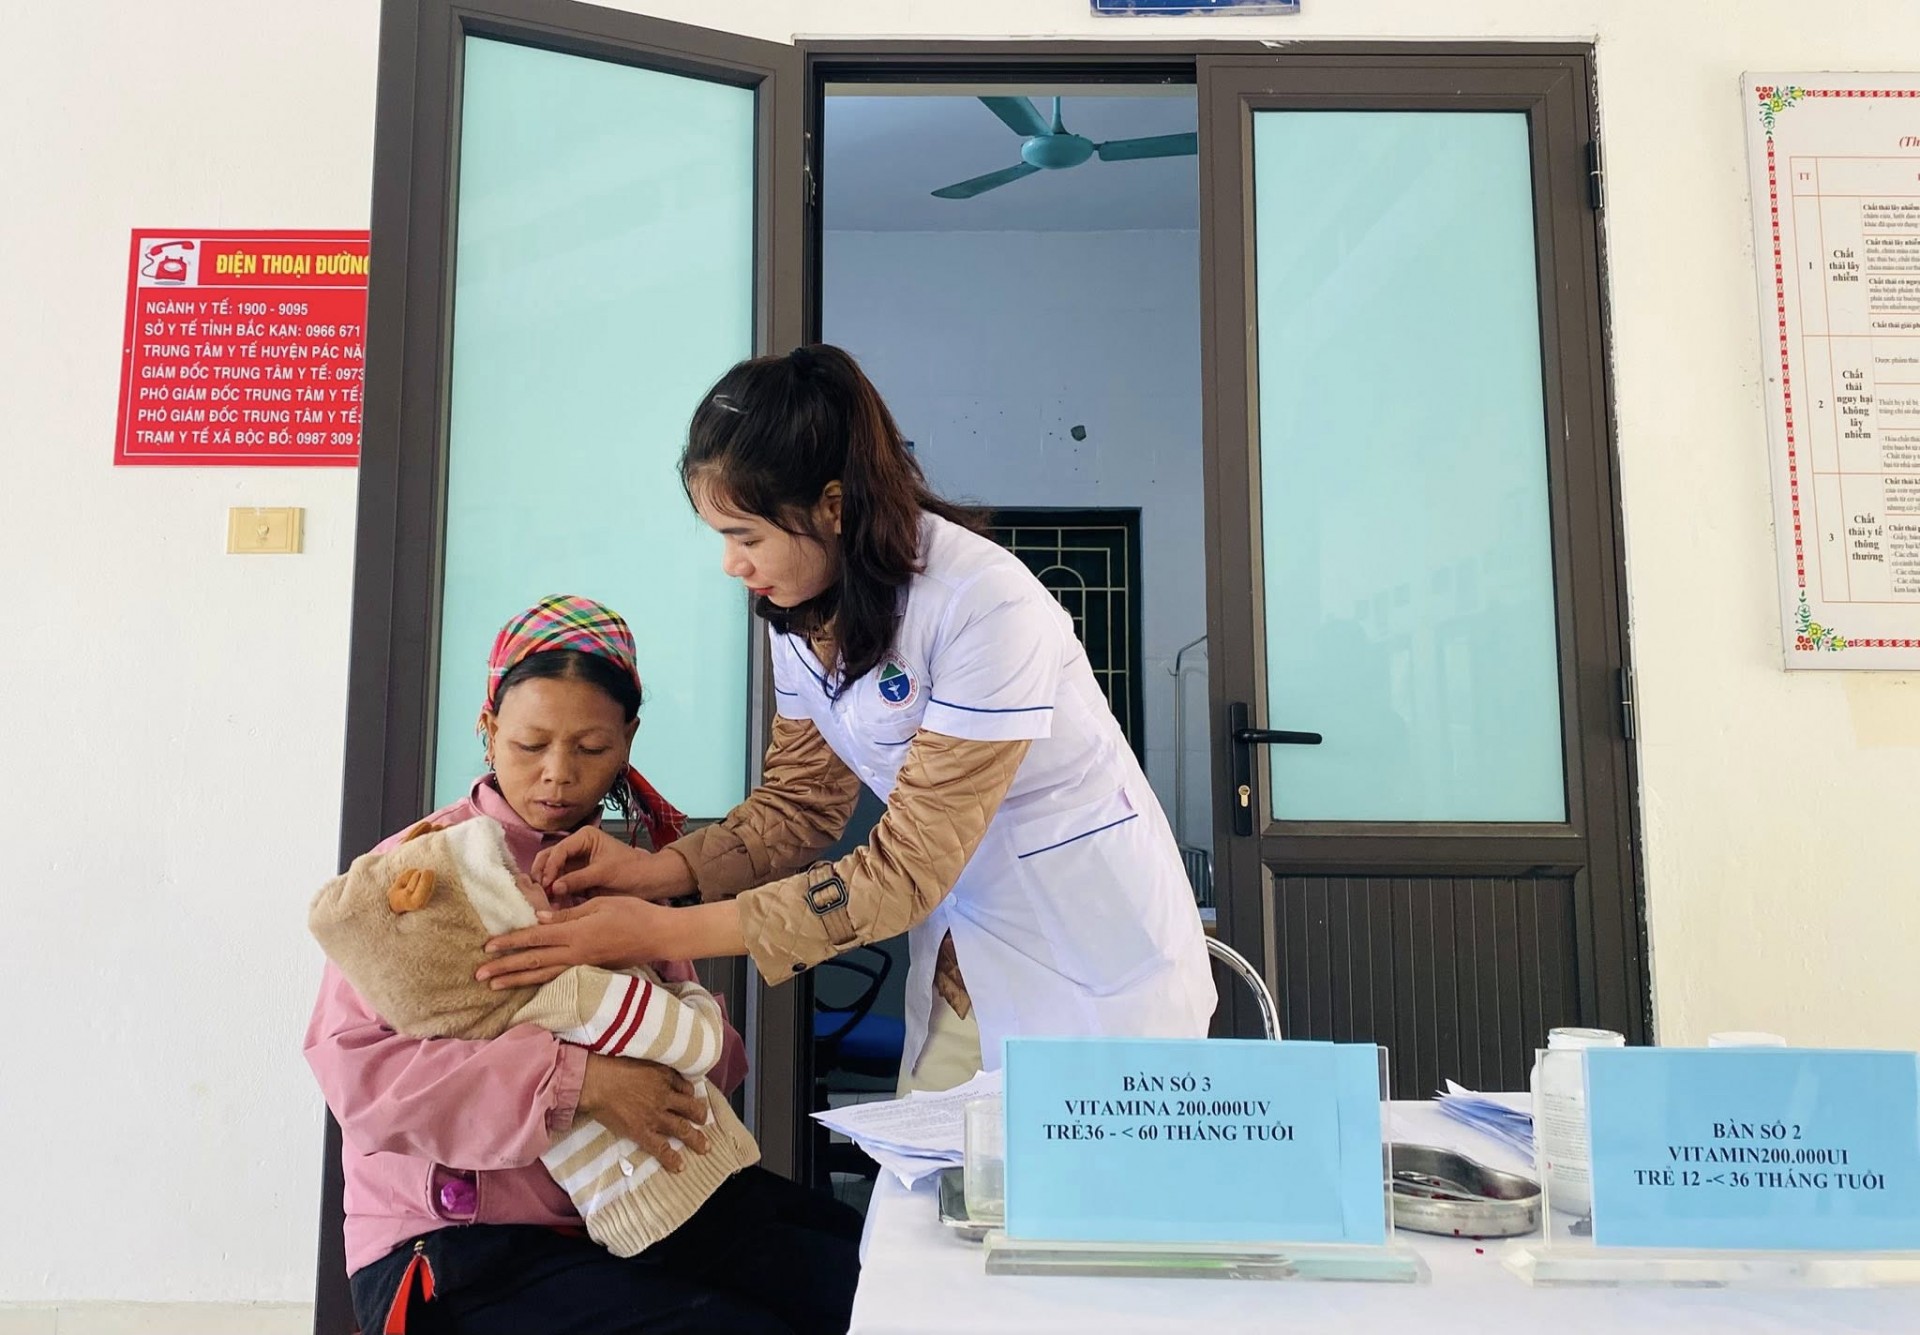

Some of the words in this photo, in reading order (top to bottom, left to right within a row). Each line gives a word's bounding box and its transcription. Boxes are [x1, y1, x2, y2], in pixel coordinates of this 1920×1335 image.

[1833, 248, 1854, 258] Chất
[216, 248, 257, 278] ĐIỆN
[262, 255, 310, 278] THOẠI
[1848, 261, 1859, 271] lây
[1833, 272, 1858, 281] nhiễm
[146, 298, 194, 315] NGÀNH
[199, 302, 208, 315] Y
[212, 297, 232, 315] TẾ:
[238, 303, 266, 315] 1900
[279, 303, 308, 316] 9095
[145, 319, 164, 336] SỞ
[167, 325, 177, 336] Y
[181, 319, 198, 336] TẾ
[202, 321, 232, 337] TỈNH
[237, 319, 264, 337] BẮC
[269, 325, 301, 339] KẠN:
[306, 325, 335, 337] 0966
[339, 326, 360, 337] 671
[143, 345, 190, 357] TRUNG
[195, 343, 222, 357] TÂM
[227, 345, 236, 357] Y
[240, 341, 257, 358] TẾ
[261, 344, 307, 360] HUYỆN
[312, 343, 339, 358] PÁC
[344, 343, 365, 360] NẶ
[141, 363, 175, 379] GIÁM
[180, 362, 209, 379] ĐỐC
[214, 366, 260, 379] TRUNG
[265, 364, 293, 379] TÂM
[298, 367, 306, 379] Y
[310, 363, 332, 379] TẾ:
[1842, 368, 1863, 379] Chất
[140, 385, 168, 400] PHÓ
[172, 385, 206, 400] GIÁM
[211, 383, 240, 401] ĐỐC
[244, 388, 291, 401] TRUNG
[296, 386, 323, 401] TÂM
[329, 389, 338, 401] Y
[342, 385, 363, 402] TẾ:
[1860, 395, 1873, 405] hại
[1818, 400, 1824, 409] 2
[1843, 407, 1869, 416] không
[138, 406, 167, 421] PHÓ
[171, 406, 204, 421] GIÁM
[209, 404, 238, 422] ĐỐC
[243, 410, 290, 422] TRUNG
[295, 407, 322, 422] TÂM
[327, 410, 336, 422] Y
[1850, 418, 1863, 427] lây
[136, 430, 174, 445] TRẠM
[179, 431, 187, 443] Y
[192, 427, 209, 443] TẾ
[213, 429, 231, 443] XÃ
[235, 430, 264, 447] BỘC
[269, 427, 292, 444] BỐ:
[296, 432, 326, 444] 0987
[330, 432, 352, 444] 309
[1845, 427, 1871, 438] nhiễm
[1854, 513, 1875, 523] Chất
[1829, 533, 1834, 541] 3
[1849, 528, 1865, 536] thải
[1868, 530, 1872, 538] y
[1875, 525, 1883, 536] tế
[1854, 540, 1879, 550] thông
[1852, 552, 1884, 562] thường
[1123, 1072, 1164, 1092] BÀN
[1170, 1072, 1196, 1092] SỐ
[1202, 1077, 1211, 1092] 3
[1064, 1100, 1170, 1116] VITAMINA
[1176, 1100, 1271, 1117] 200.000UV
[1043, 1120, 1104, 1140] TRẺ36
[1122, 1127, 1133, 1139] <
[1138, 1125, 1158, 1140] 60
[1163, 1120, 1237, 1141] THÁNG
[1242, 1121, 1294, 1141] TUỔI
[1713, 1118, 1754, 1139] BÀN
[1760, 1119, 1786, 1140] SỐ
[1793, 1124, 1801, 1140] 2
[1668, 1146, 1849, 1165] VITAMIN200.000UI
[1634, 1165, 1674, 1186] TRẺ
[1682, 1171, 1700, 1186] 12
[1730, 1172, 1749, 1187] 36
[1755, 1168, 1828, 1189] THÁNG
[1834, 1169, 1885, 1189] TUỔI
